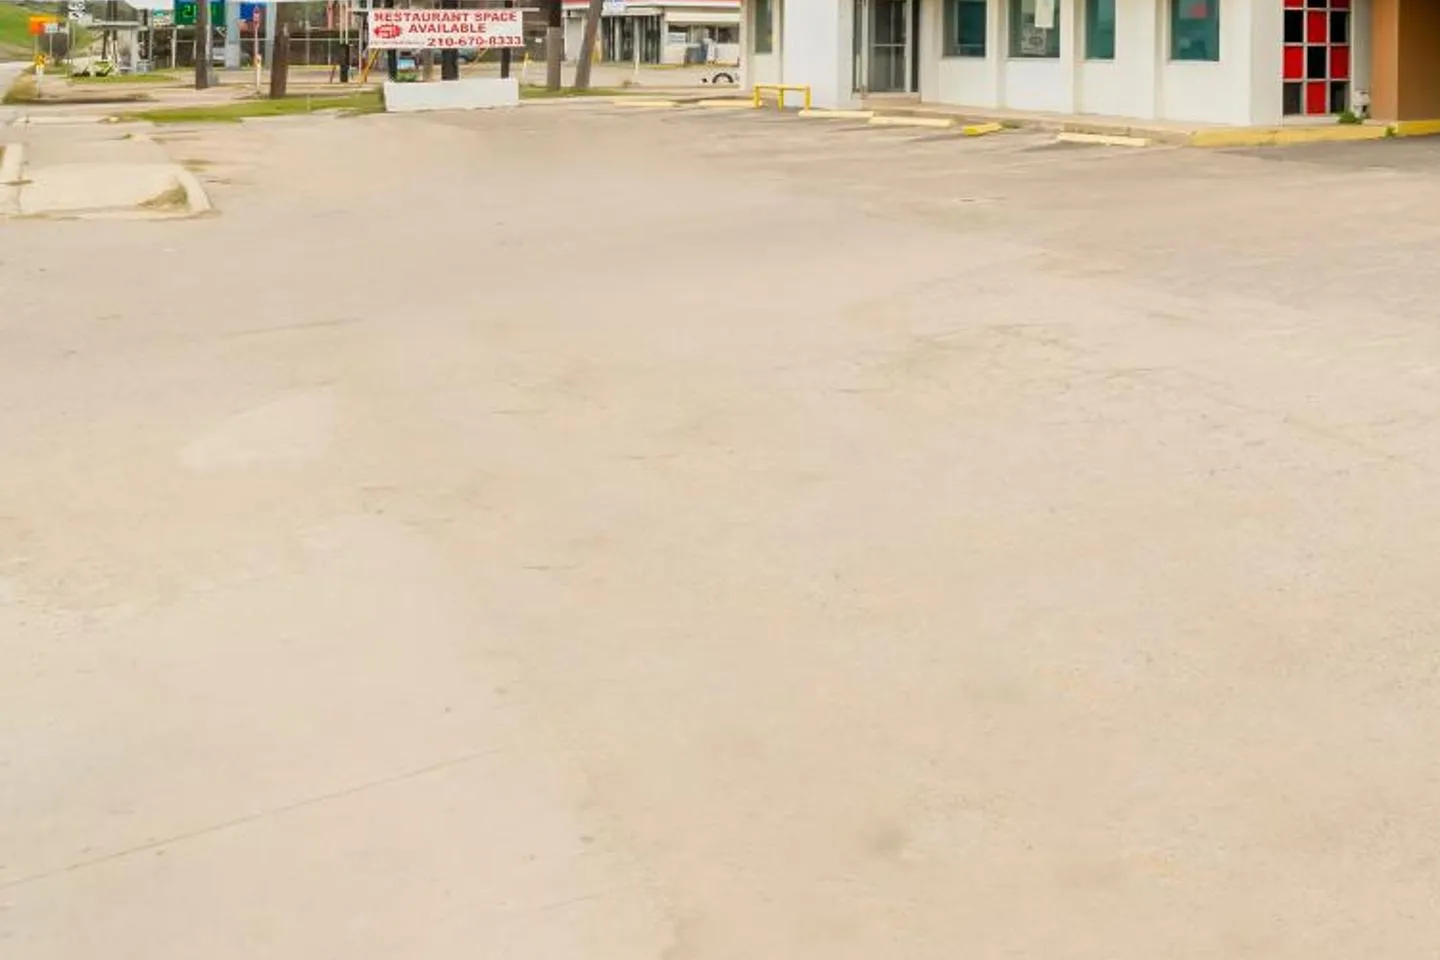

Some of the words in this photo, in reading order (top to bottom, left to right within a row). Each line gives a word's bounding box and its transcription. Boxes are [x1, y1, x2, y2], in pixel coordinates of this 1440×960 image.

[373, 11, 469, 23] RESTAURANT
[474, 11, 518, 23] SPACE
[407, 22, 487, 34] AVAILABLE
